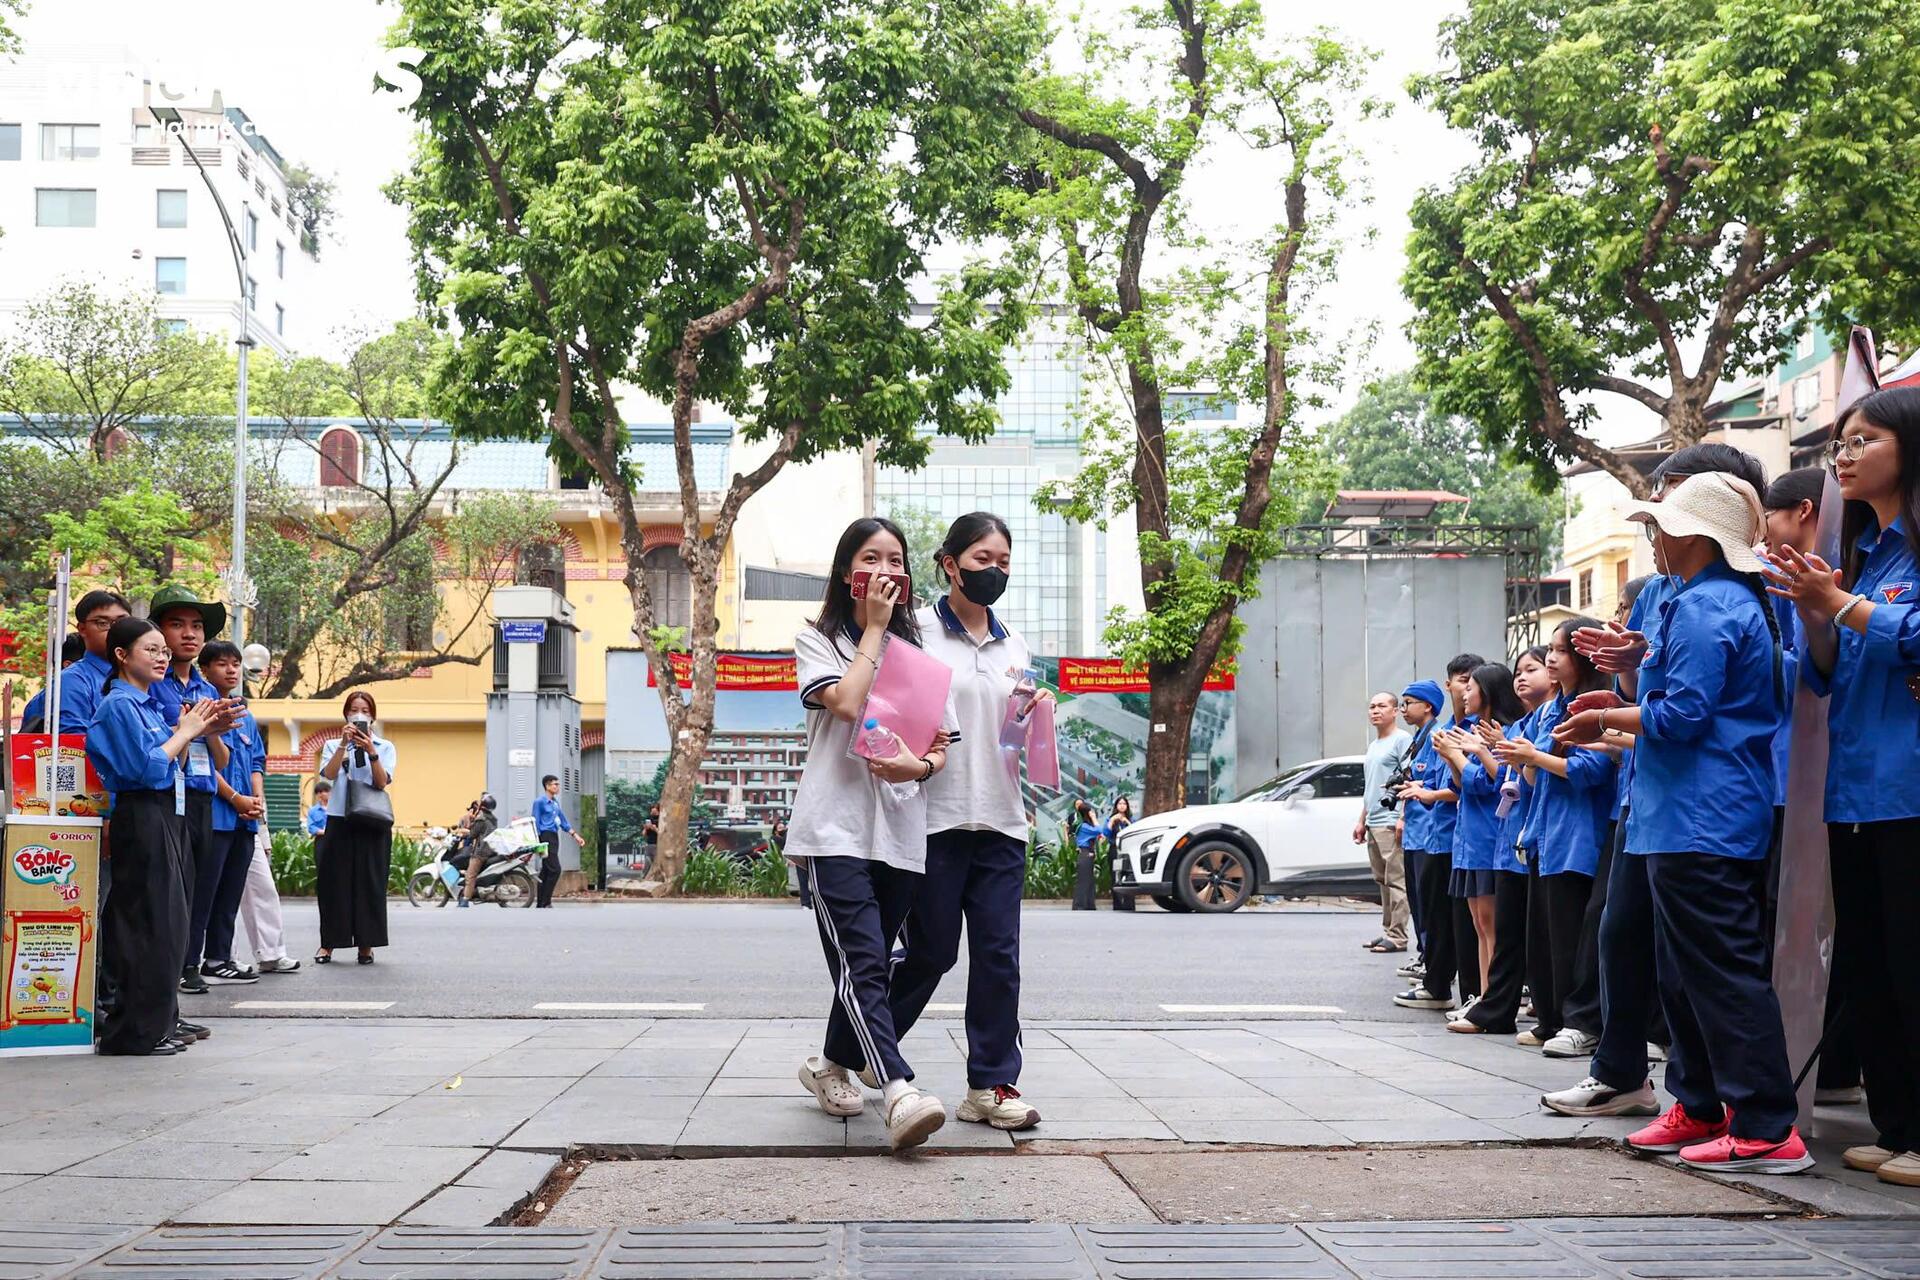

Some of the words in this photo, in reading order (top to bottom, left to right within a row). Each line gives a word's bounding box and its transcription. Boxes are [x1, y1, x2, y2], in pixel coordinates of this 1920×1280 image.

[1079, 676, 1094, 684] SINH
[61, 833, 93, 841] ORION
[16, 848, 72, 871] BỐNG
[31, 865, 62, 877] BANG
[60, 886, 80, 901] 10
